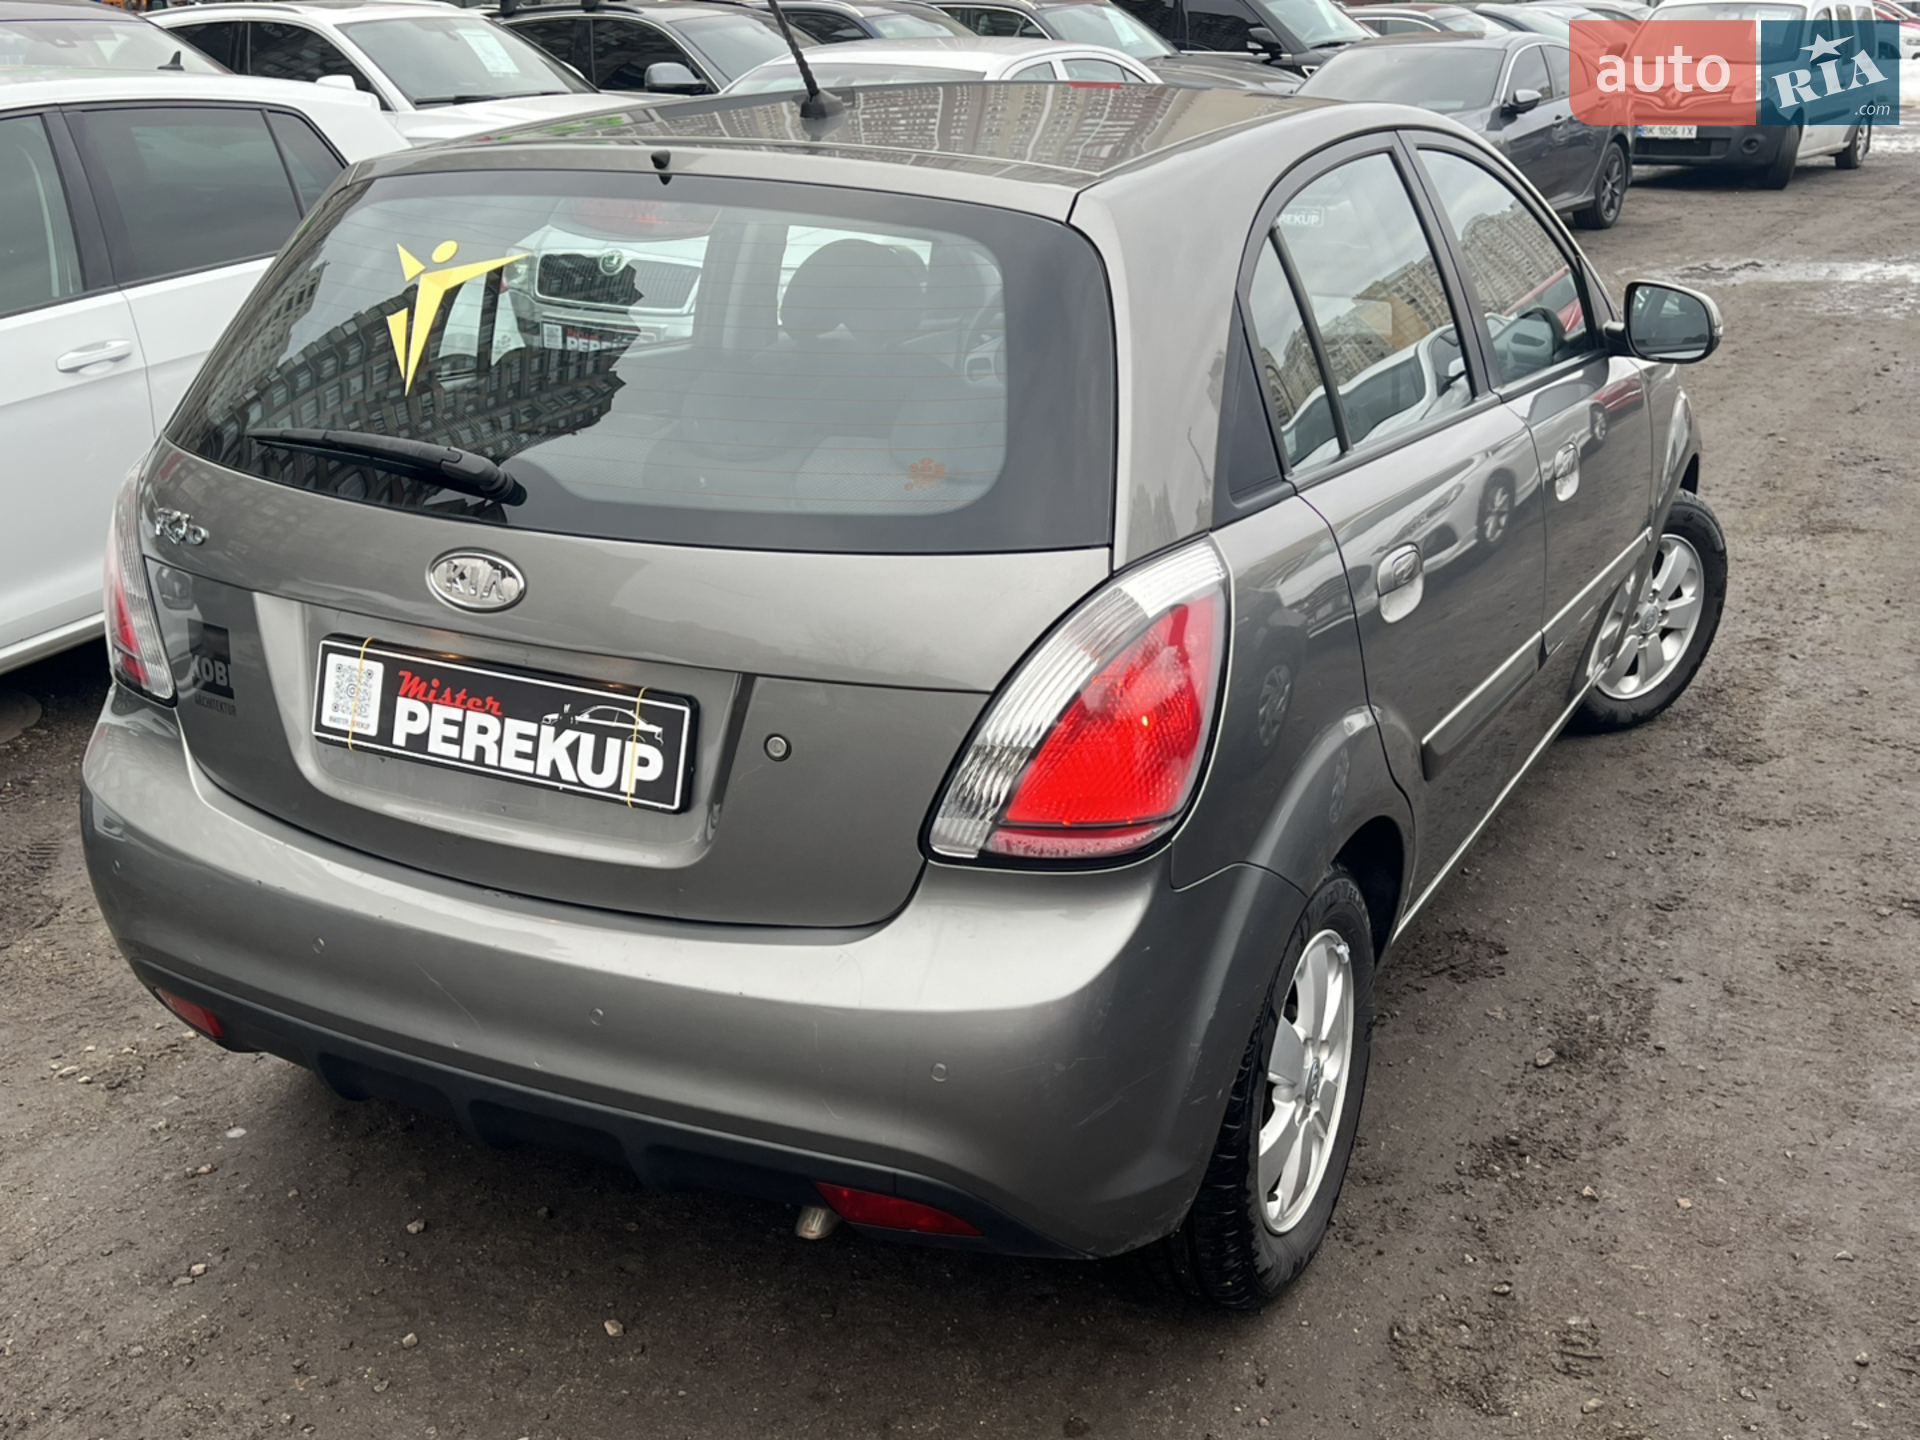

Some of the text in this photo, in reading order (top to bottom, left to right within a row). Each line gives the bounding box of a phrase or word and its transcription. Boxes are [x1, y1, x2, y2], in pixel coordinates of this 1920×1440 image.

[1658, 126, 1677, 136] 1056
[397, 669, 503, 716] Mister
[392, 697, 664, 795] PEREKUP
